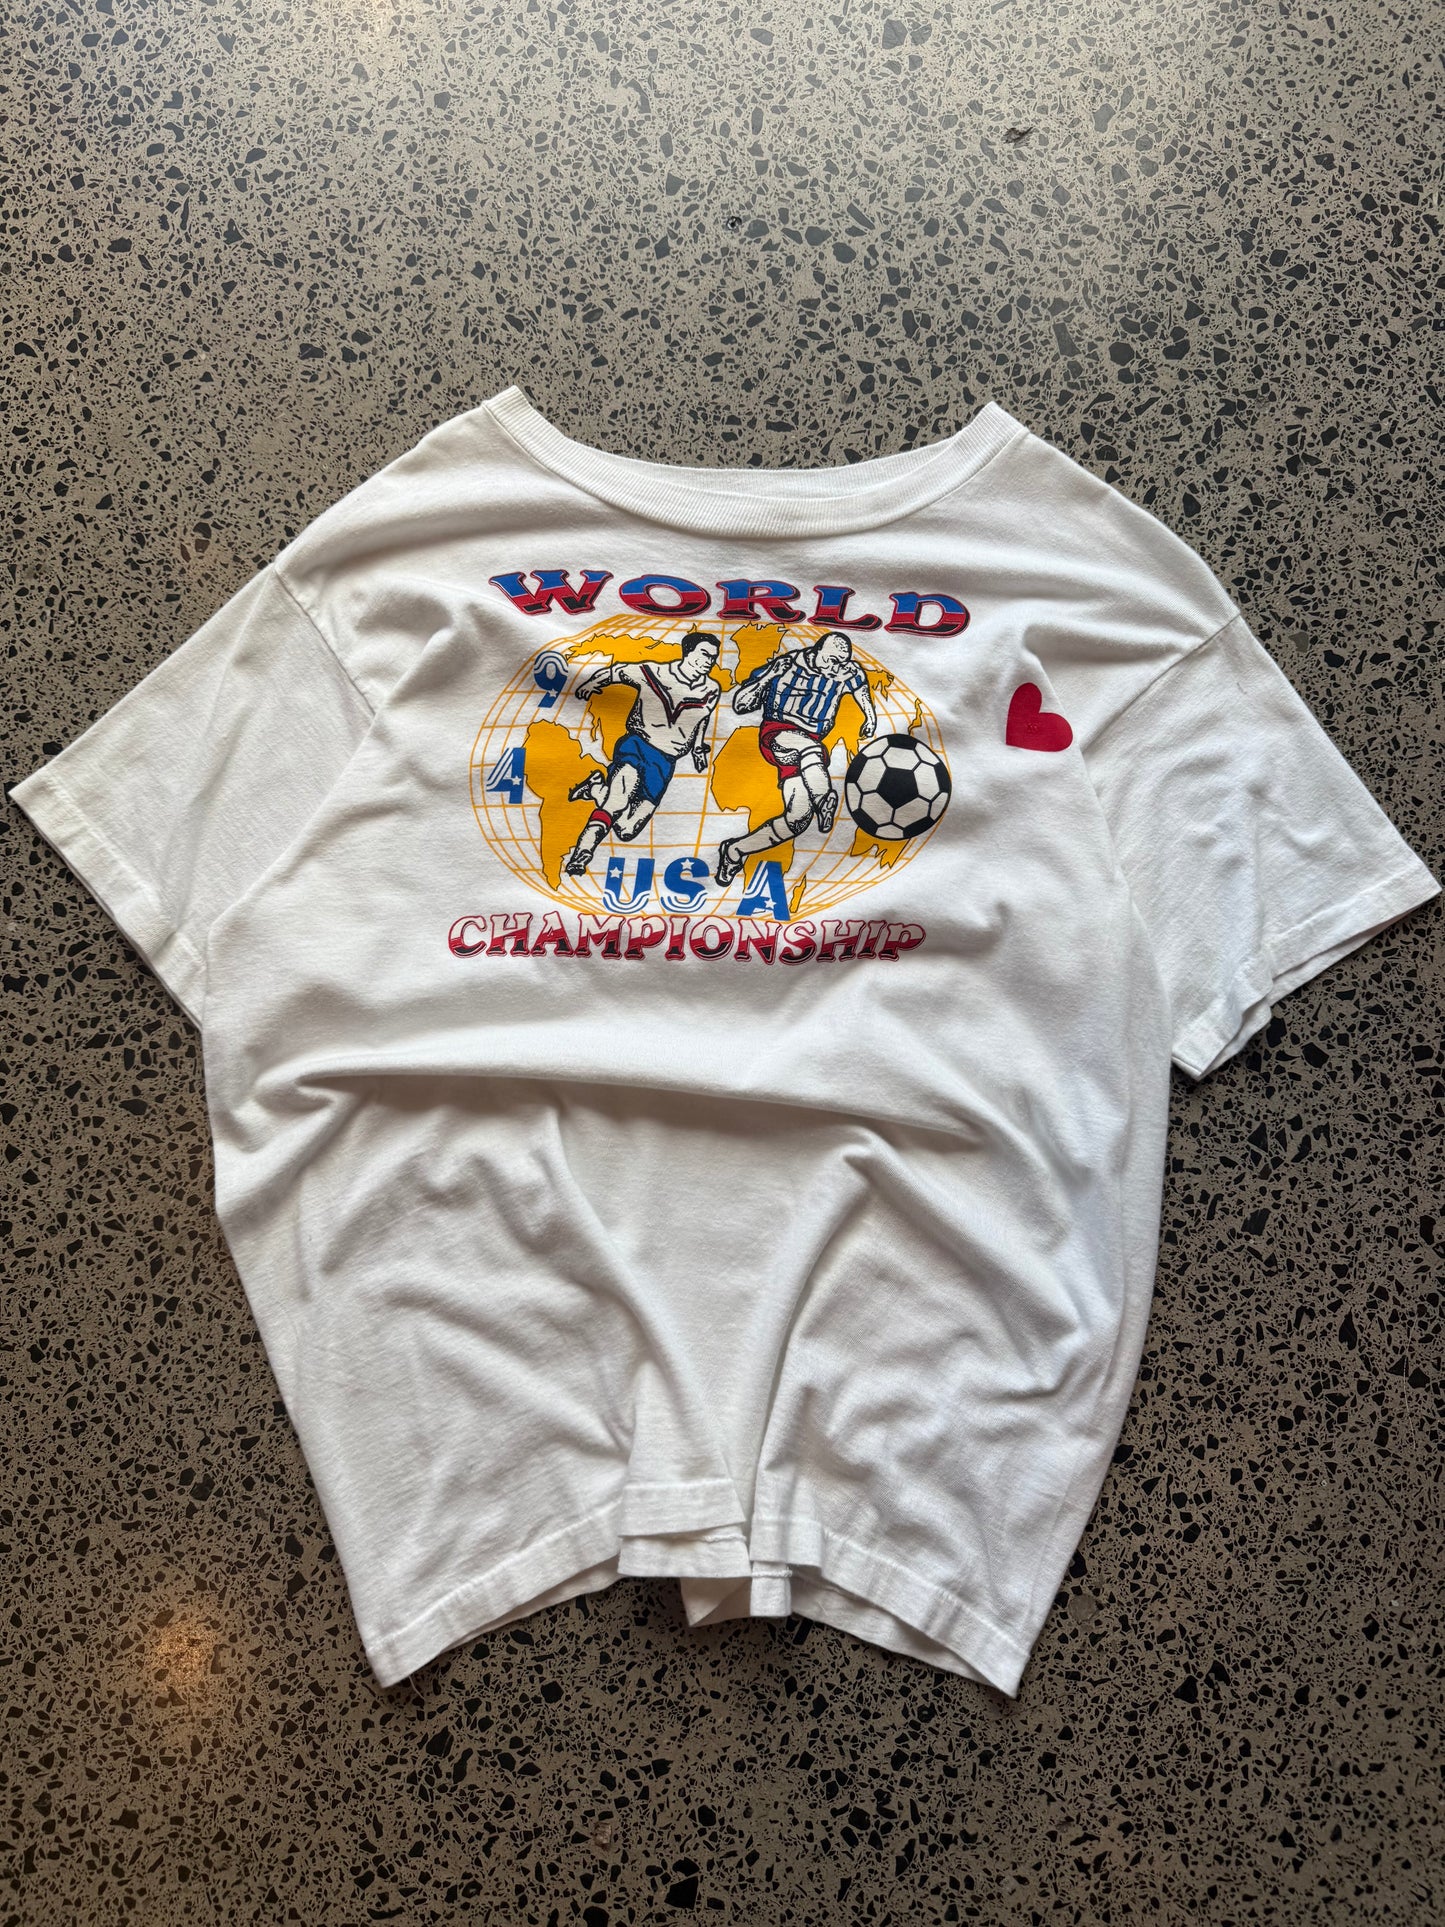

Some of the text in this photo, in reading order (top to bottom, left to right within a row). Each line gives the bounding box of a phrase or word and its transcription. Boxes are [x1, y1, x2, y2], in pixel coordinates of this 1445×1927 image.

[489, 569, 970, 637] WORLD
[603, 857, 791, 921] USA
[448, 911, 926, 966] CHAMPIONSHIP
